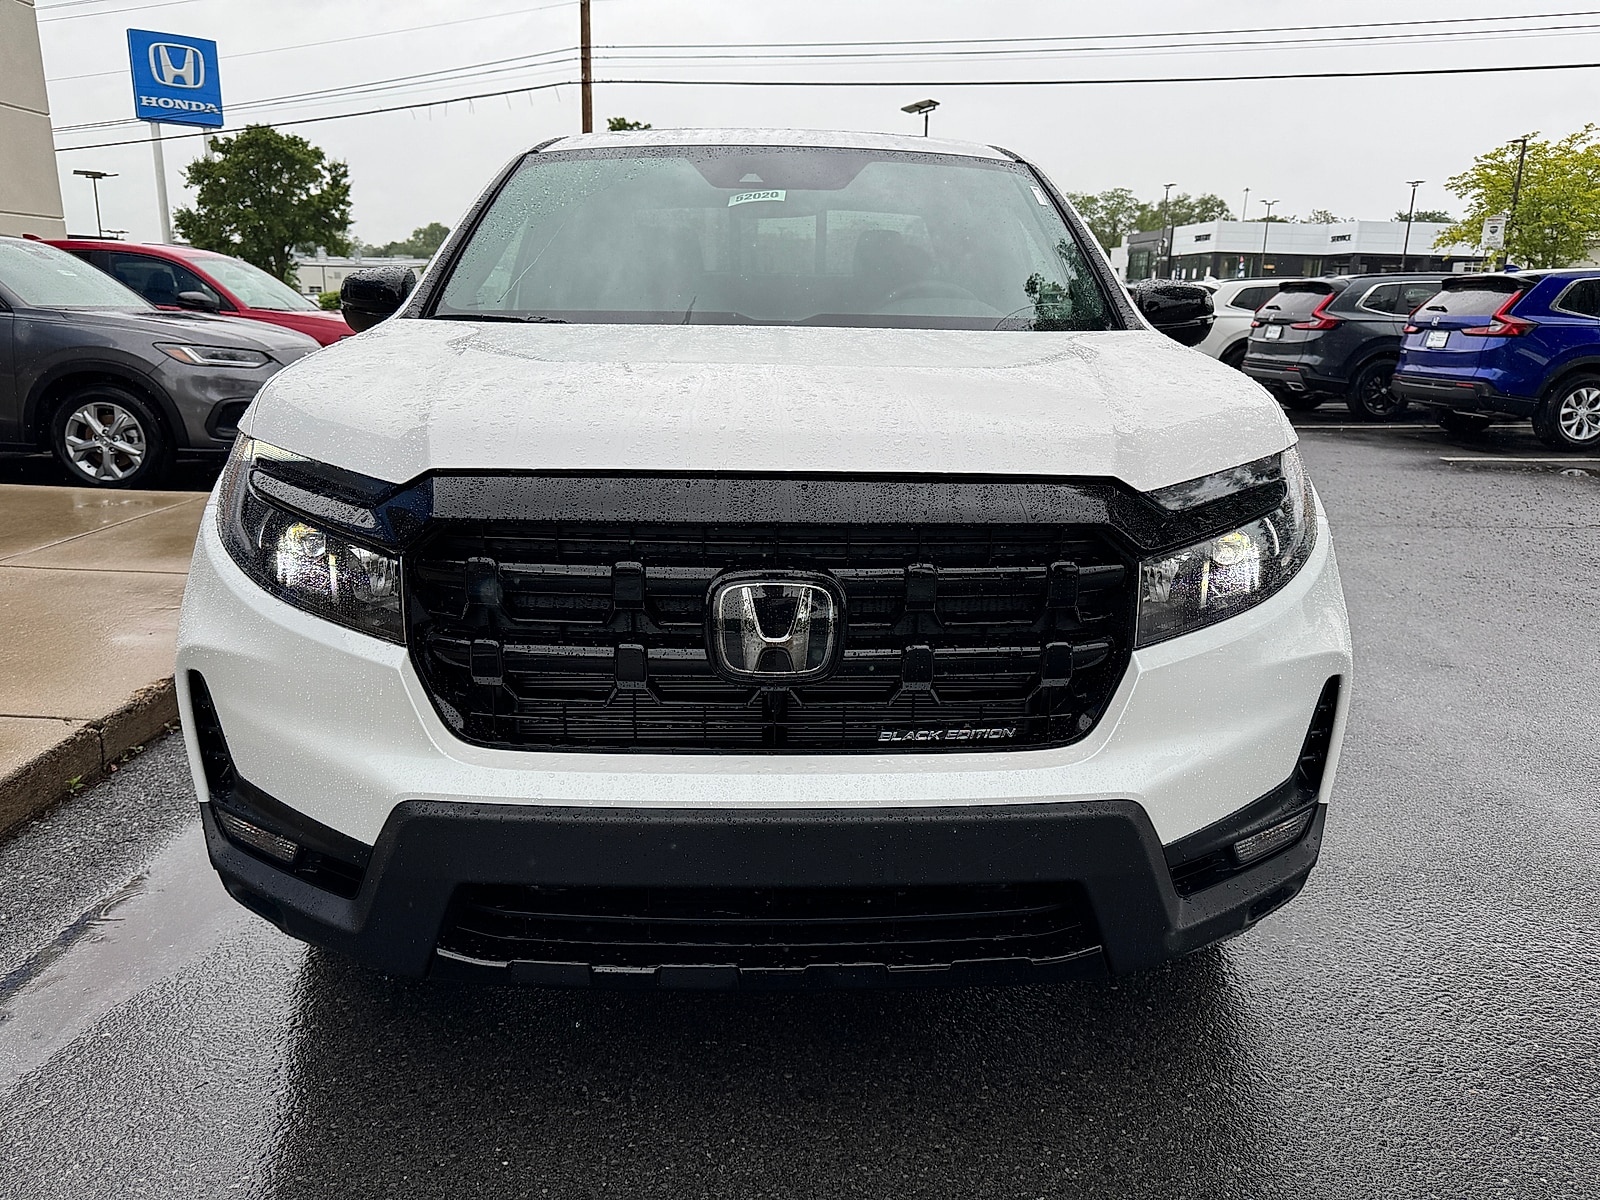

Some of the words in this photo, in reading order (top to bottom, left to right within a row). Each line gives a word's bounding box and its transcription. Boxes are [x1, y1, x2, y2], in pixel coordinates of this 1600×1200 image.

[140, 96, 221, 114] HONDA
[736, 191, 779, 203] 52020
[878, 730, 943, 741] BLACK
[944, 727, 1016, 740] EDITION
